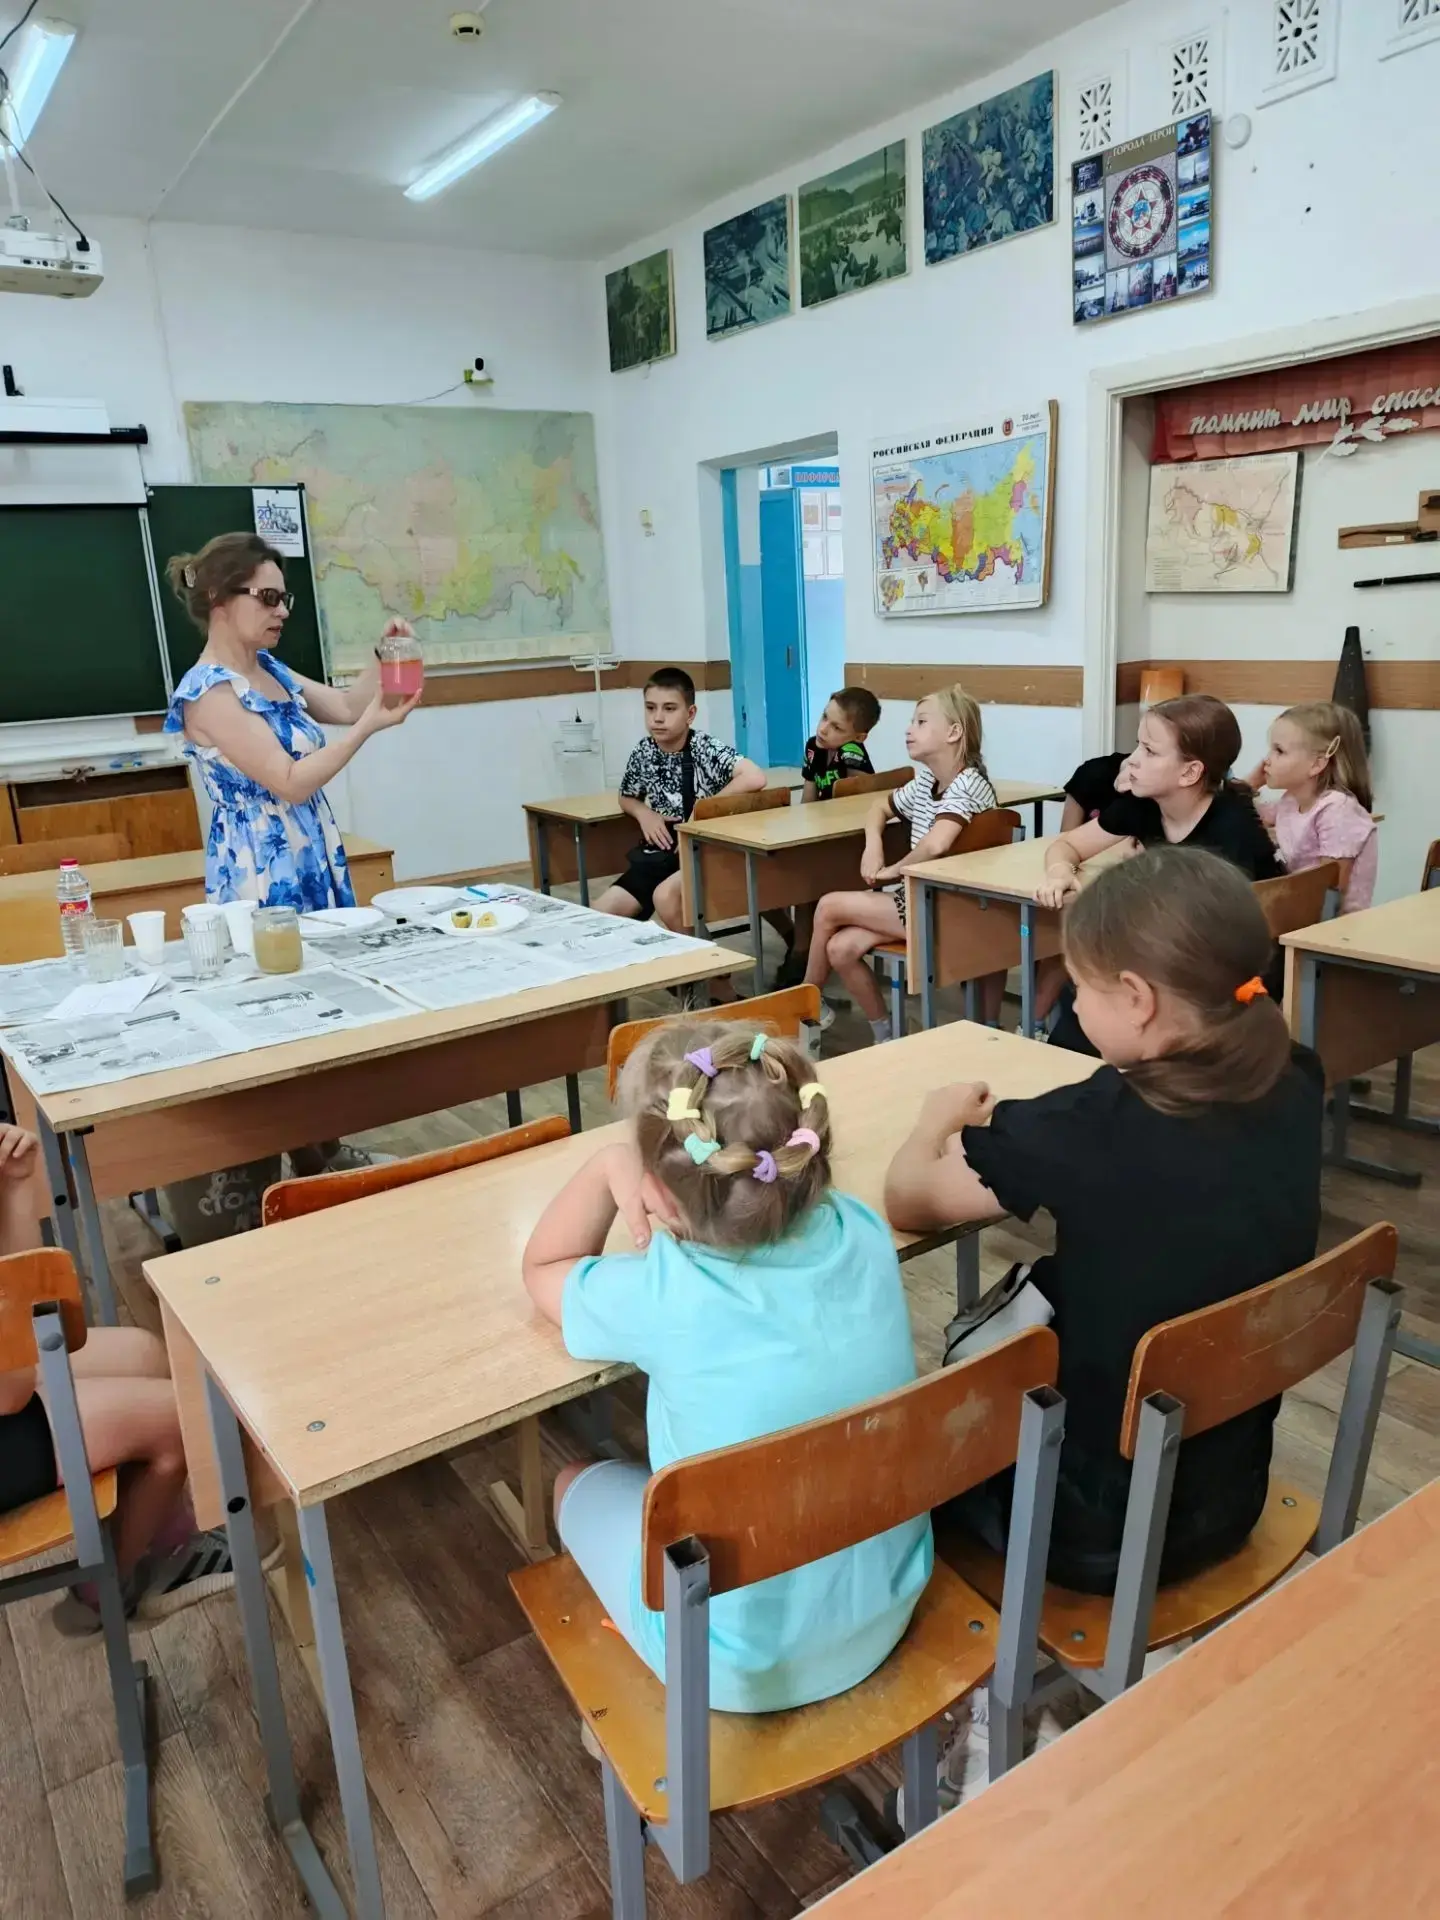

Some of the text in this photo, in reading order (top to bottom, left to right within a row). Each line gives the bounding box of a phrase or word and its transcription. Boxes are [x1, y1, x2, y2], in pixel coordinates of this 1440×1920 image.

[1113, 137, 1145, 157] ГОРОДА
[1149, 125, 1176, 143] ГЕРОИ
[1188, 408, 1281, 435] помнит
[1292, 397, 1352, 428] мир
[873, 426, 994, 459] РОССИЙСКАЯ ФЕДЕРАЦИЯ
